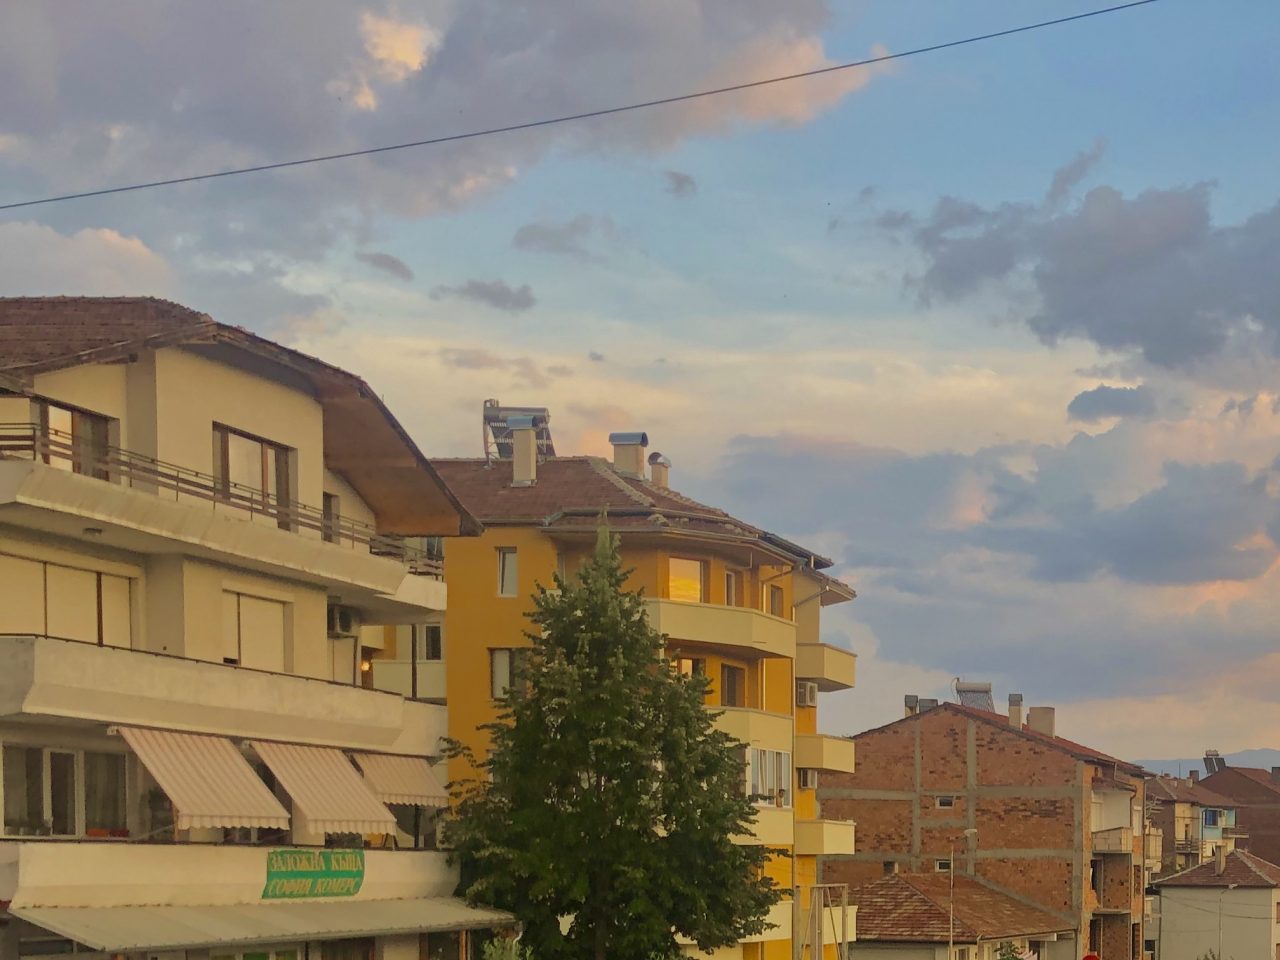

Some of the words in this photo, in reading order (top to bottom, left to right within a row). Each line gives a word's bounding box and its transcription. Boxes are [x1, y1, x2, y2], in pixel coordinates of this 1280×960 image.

[271, 853, 325, 871] ЗАЛОЖНА
[331, 853, 361, 872] КЪЩА
[269, 879, 312, 895] СОФИЯ
